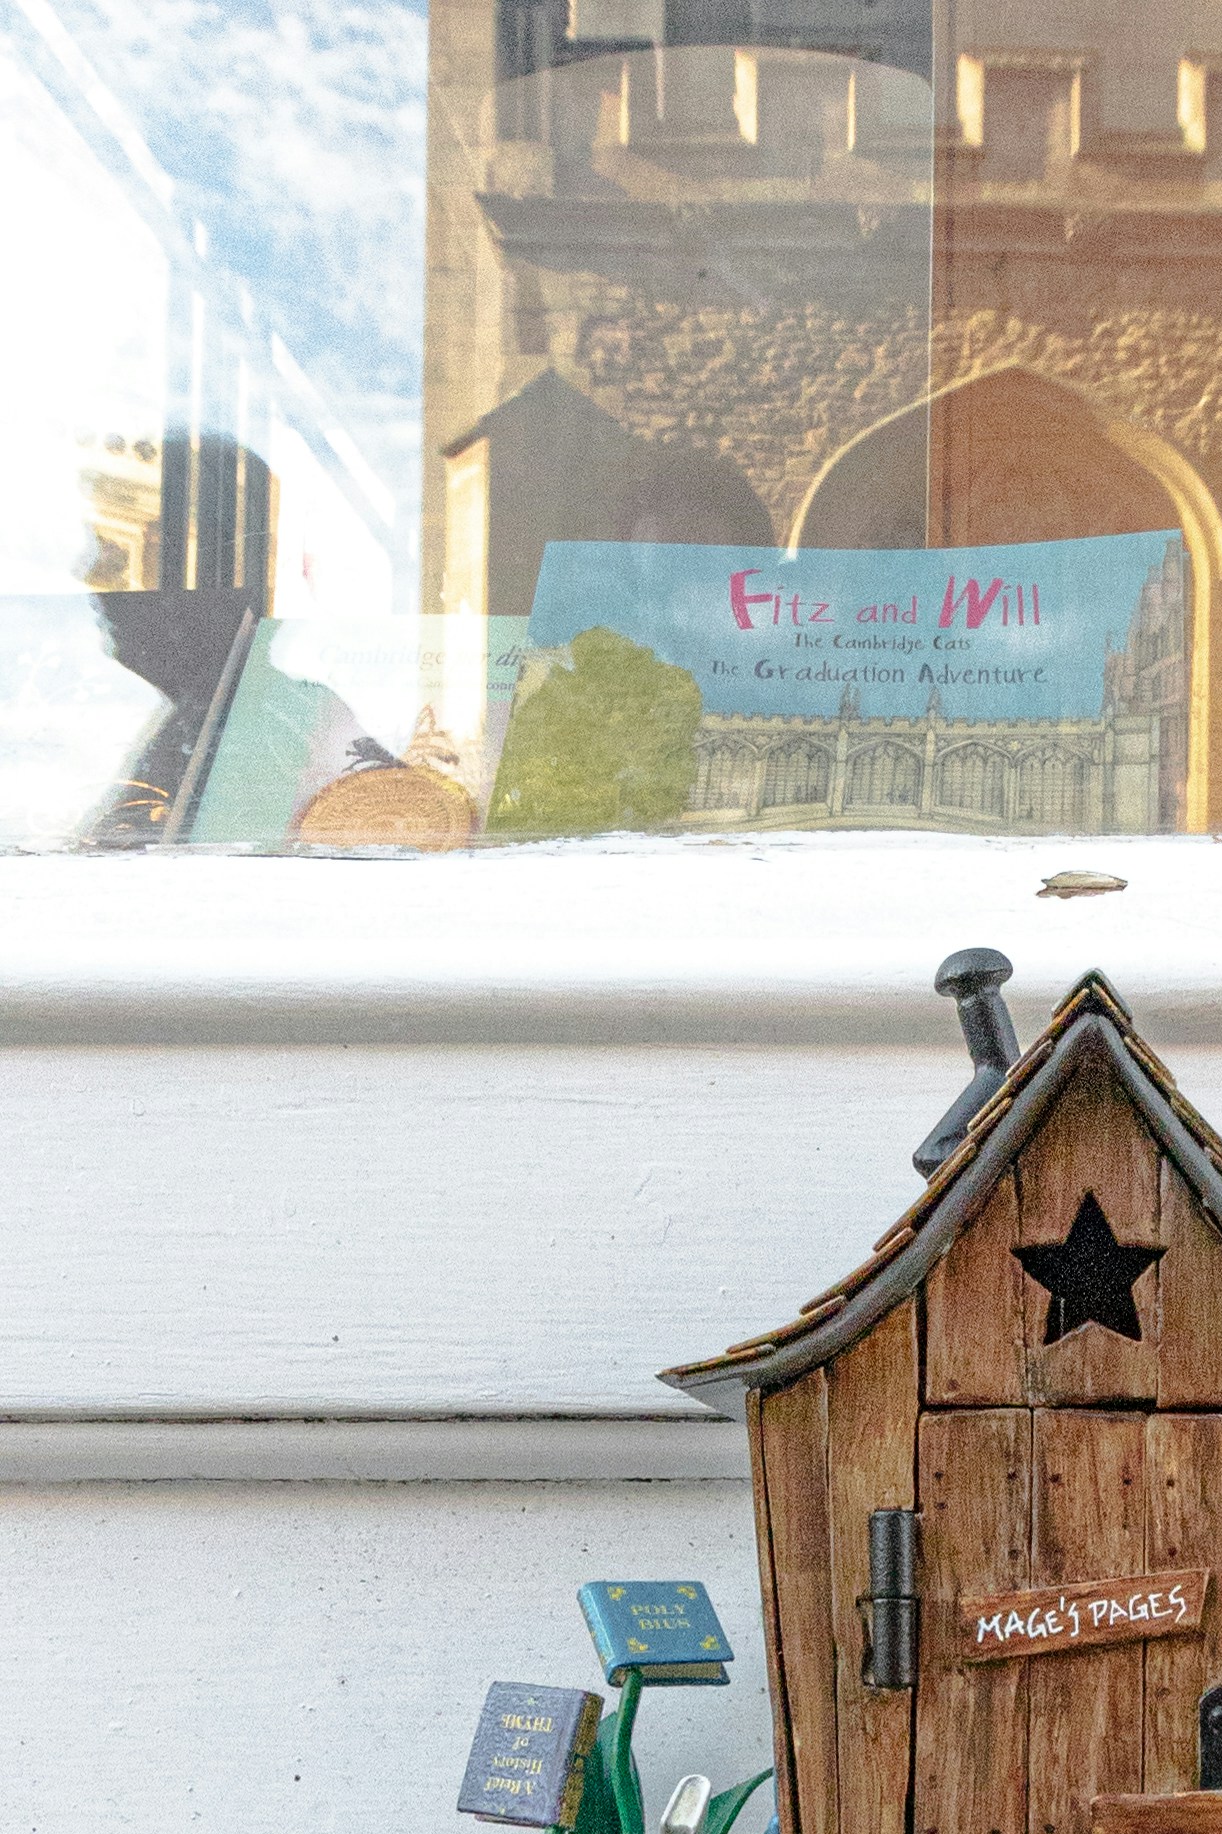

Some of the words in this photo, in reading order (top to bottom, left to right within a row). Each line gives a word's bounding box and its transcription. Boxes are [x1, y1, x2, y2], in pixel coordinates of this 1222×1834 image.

[728, 566, 835, 631] Fitz
[856, 596, 918, 626] and
[937, 574, 1042, 630] Will
[794, 632, 824, 650] The
[832, 632, 925, 653] Cambridge
[931, 633, 971, 652] Cats
[711, 659, 740, 678] The
[753, 656, 906, 684] Graduation
[917, 660, 1048, 685] Adventure
[630, 1604, 685, 1616] POLY
[1088, 1584, 1188, 1627] PAGES
[638, 1618, 692, 1631] BIUS
[501, 1713, 554, 1733] THYME
[511, 1736, 529, 1751] of
[492, 1754, 543, 1775] History
